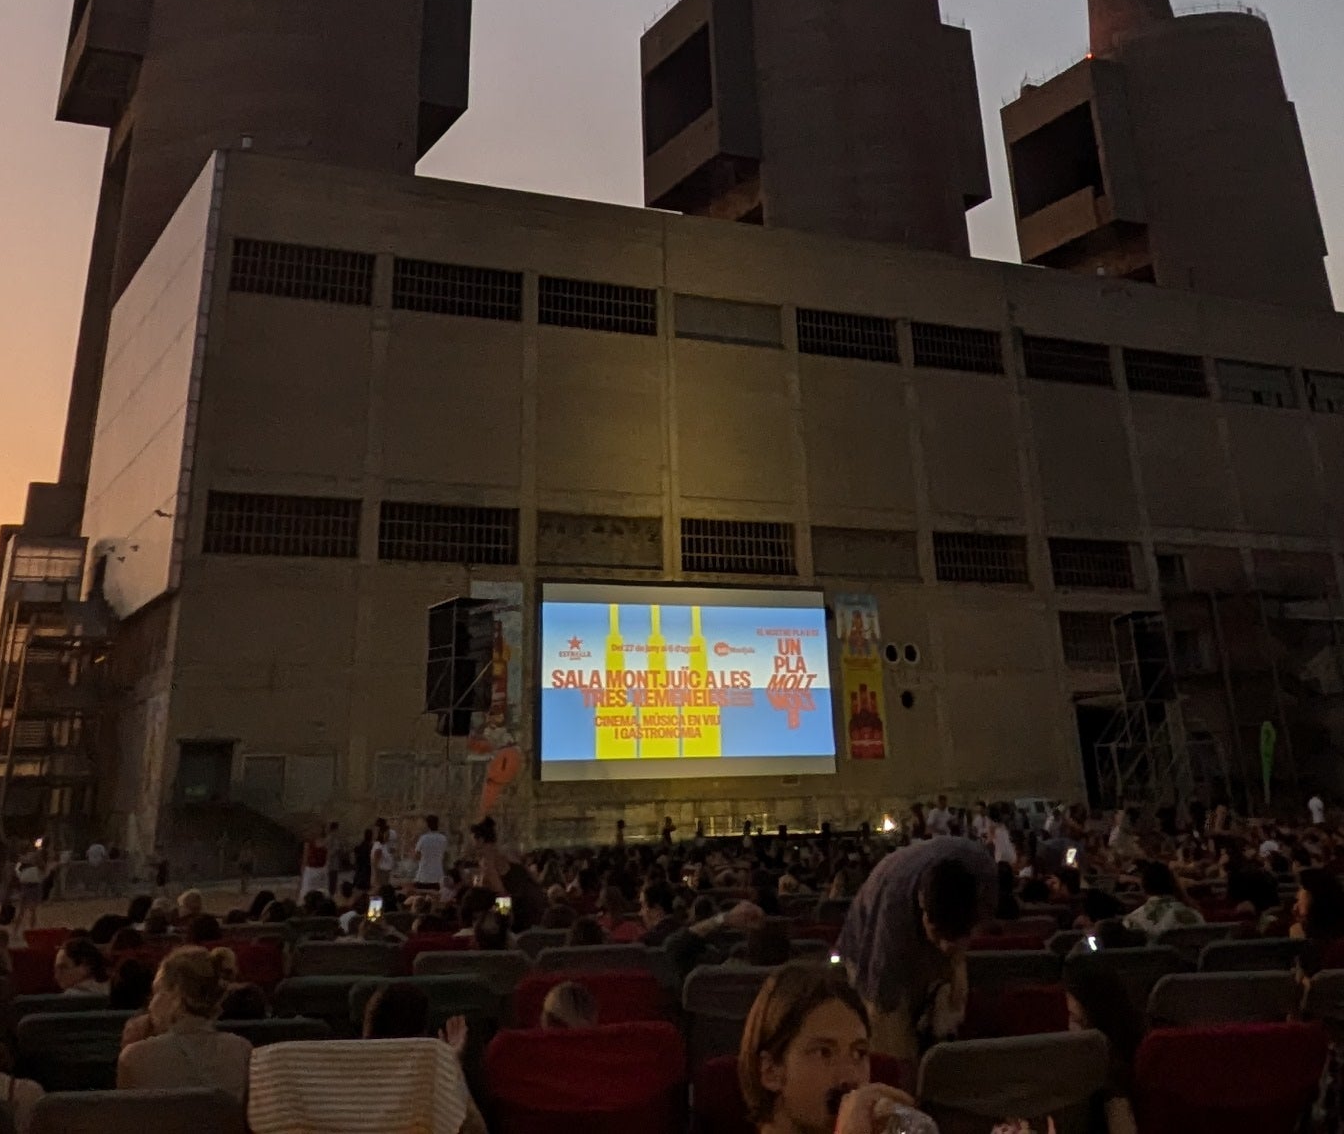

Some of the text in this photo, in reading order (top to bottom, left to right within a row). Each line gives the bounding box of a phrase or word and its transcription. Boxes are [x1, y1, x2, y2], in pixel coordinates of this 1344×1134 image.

[778, 638, 802, 655] UN
[774, 656, 806, 673] PLA
[552, 666, 751, 689] SALA MONTJUÏC A LES
[767, 674, 817, 691] MOLT
[581, 689, 628, 707] TRES
[642, 713, 686, 727] MÚSICA
[688, 715, 700, 726] EN
[704, 715, 721, 726] VIU
[614, 728, 618, 739] I
